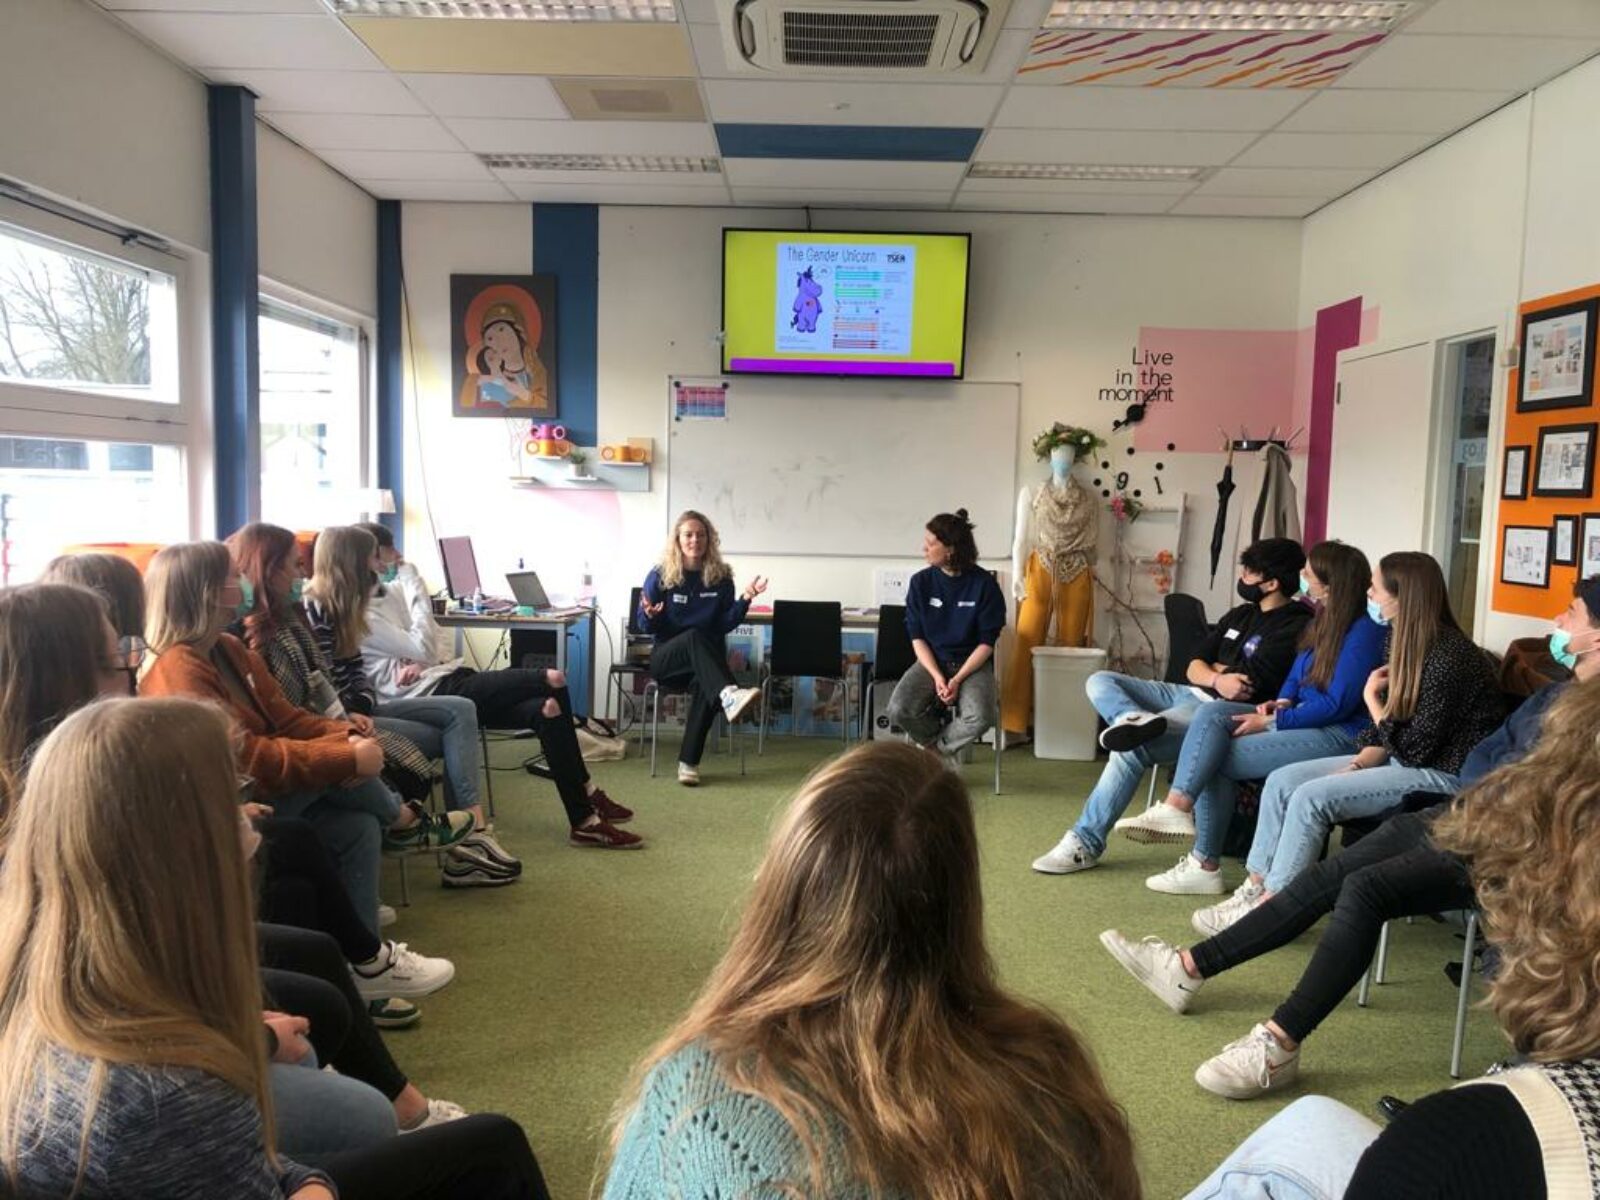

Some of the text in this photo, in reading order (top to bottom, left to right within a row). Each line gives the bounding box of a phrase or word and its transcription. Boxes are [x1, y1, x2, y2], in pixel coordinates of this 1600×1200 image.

[788, 246, 877, 263] The Gender Unicorn
[1132, 347, 1173, 365] Live
[1116, 367, 1172, 385] in the
[1099, 387, 1174, 402] moment
[735, 627, 754, 636] FIVE
